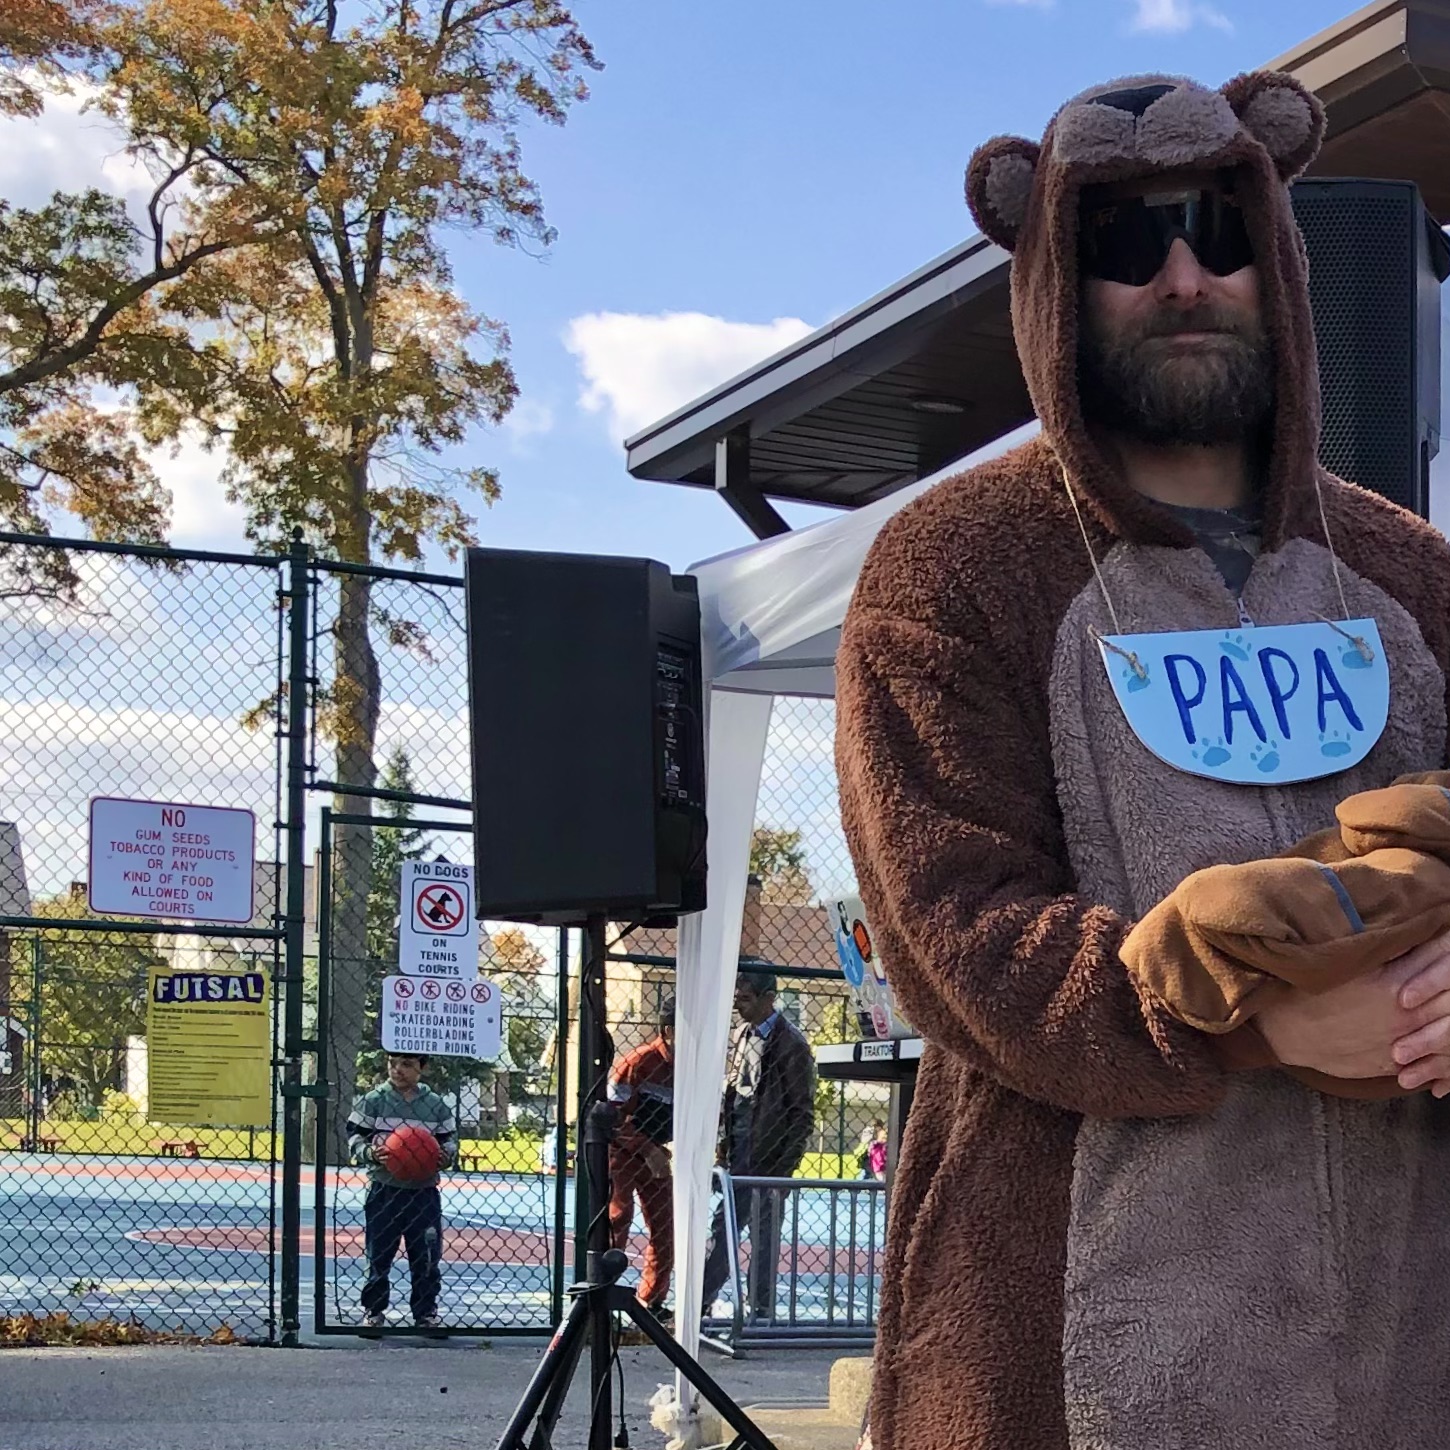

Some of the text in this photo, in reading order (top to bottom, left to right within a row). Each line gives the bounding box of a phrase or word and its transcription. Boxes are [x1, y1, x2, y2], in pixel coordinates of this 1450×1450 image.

[1163, 647, 1364, 745] PAPA
[161, 809, 186, 828] NO
[135, 829, 210, 846] GUM SEEDS
[110, 841, 236, 862] TOBACCO PRODUCTS
[147, 858, 198, 873] OR ANY
[413, 864, 469, 879] NO DOGS
[123, 871, 214, 888] KIND OF FOOD
[131, 886, 213, 902] ALLOWED ON
[149, 901, 195, 915] COURTS
[432, 938, 447, 948] ON
[420, 950, 458, 963] TENNIS
[418, 963, 460, 976] COURTS
[156, 976, 261, 1000] FUTSAL
[395, 1000, 476, 1016] NO BIKE RIDING
[394, 1013, 475, 1029] SKATEBOARDING
[394, 1026, 475, 1042] ROLLERBLADING
[394, 1039, 477, 1056] SCOOTER RIDING
